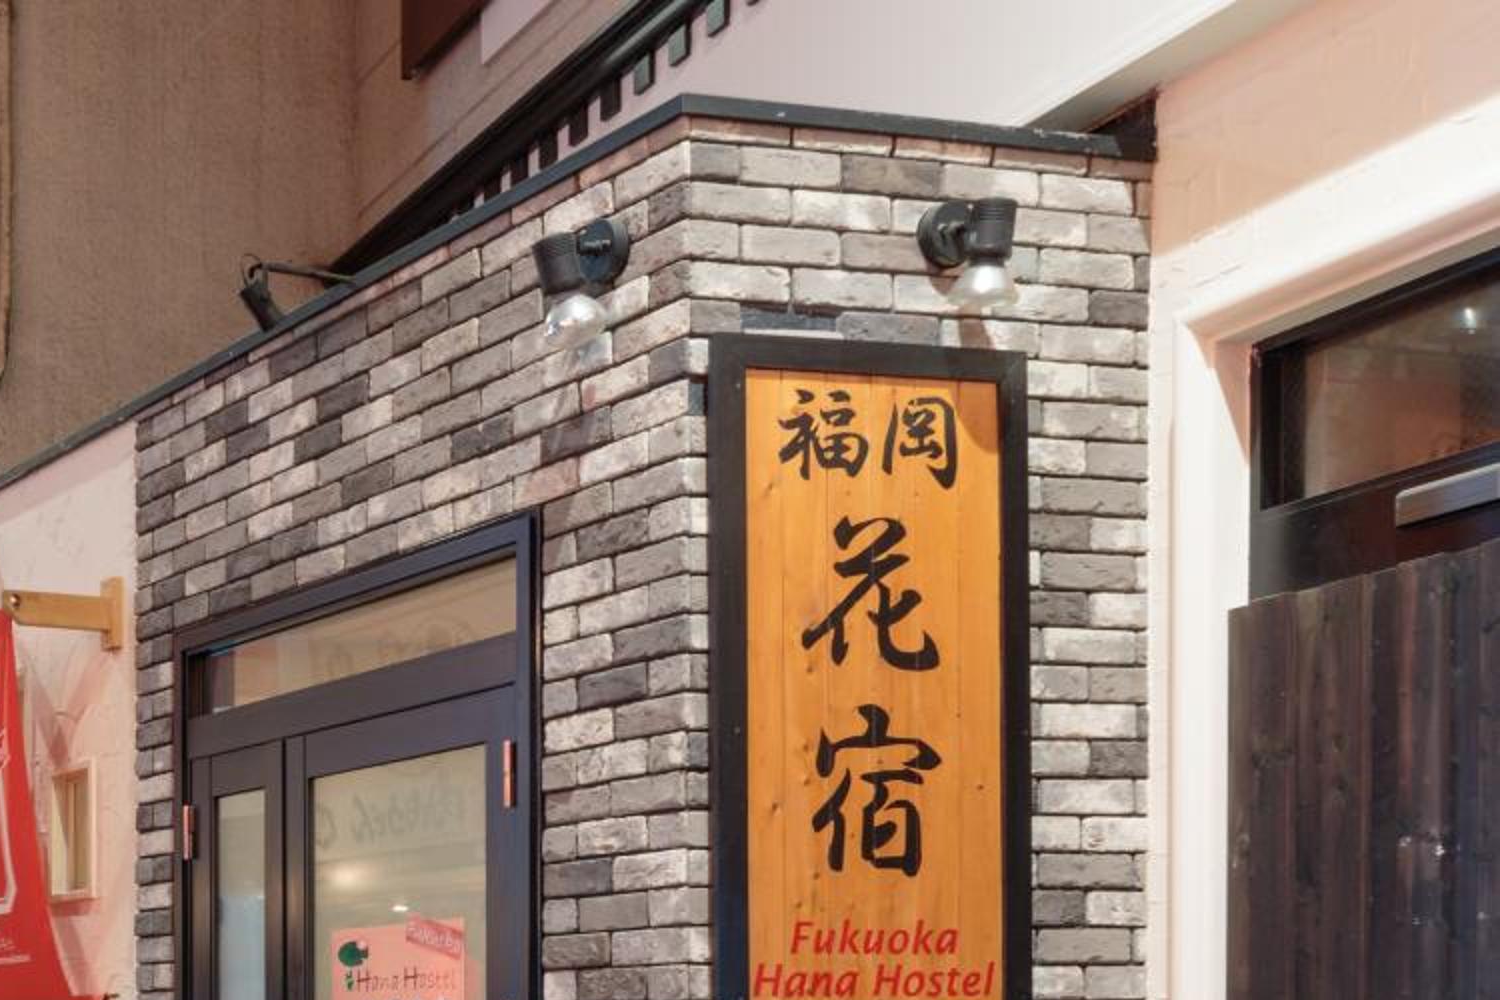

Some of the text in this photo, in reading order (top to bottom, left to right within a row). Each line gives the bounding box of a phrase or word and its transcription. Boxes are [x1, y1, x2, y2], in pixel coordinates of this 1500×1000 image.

[777, 389, 959, 489] 福岡
[801, 516, 943, 878] 花宿
[790, 920, 959, 957] Fukuoka
[753, 962, 996, 998] Hana Hostel
